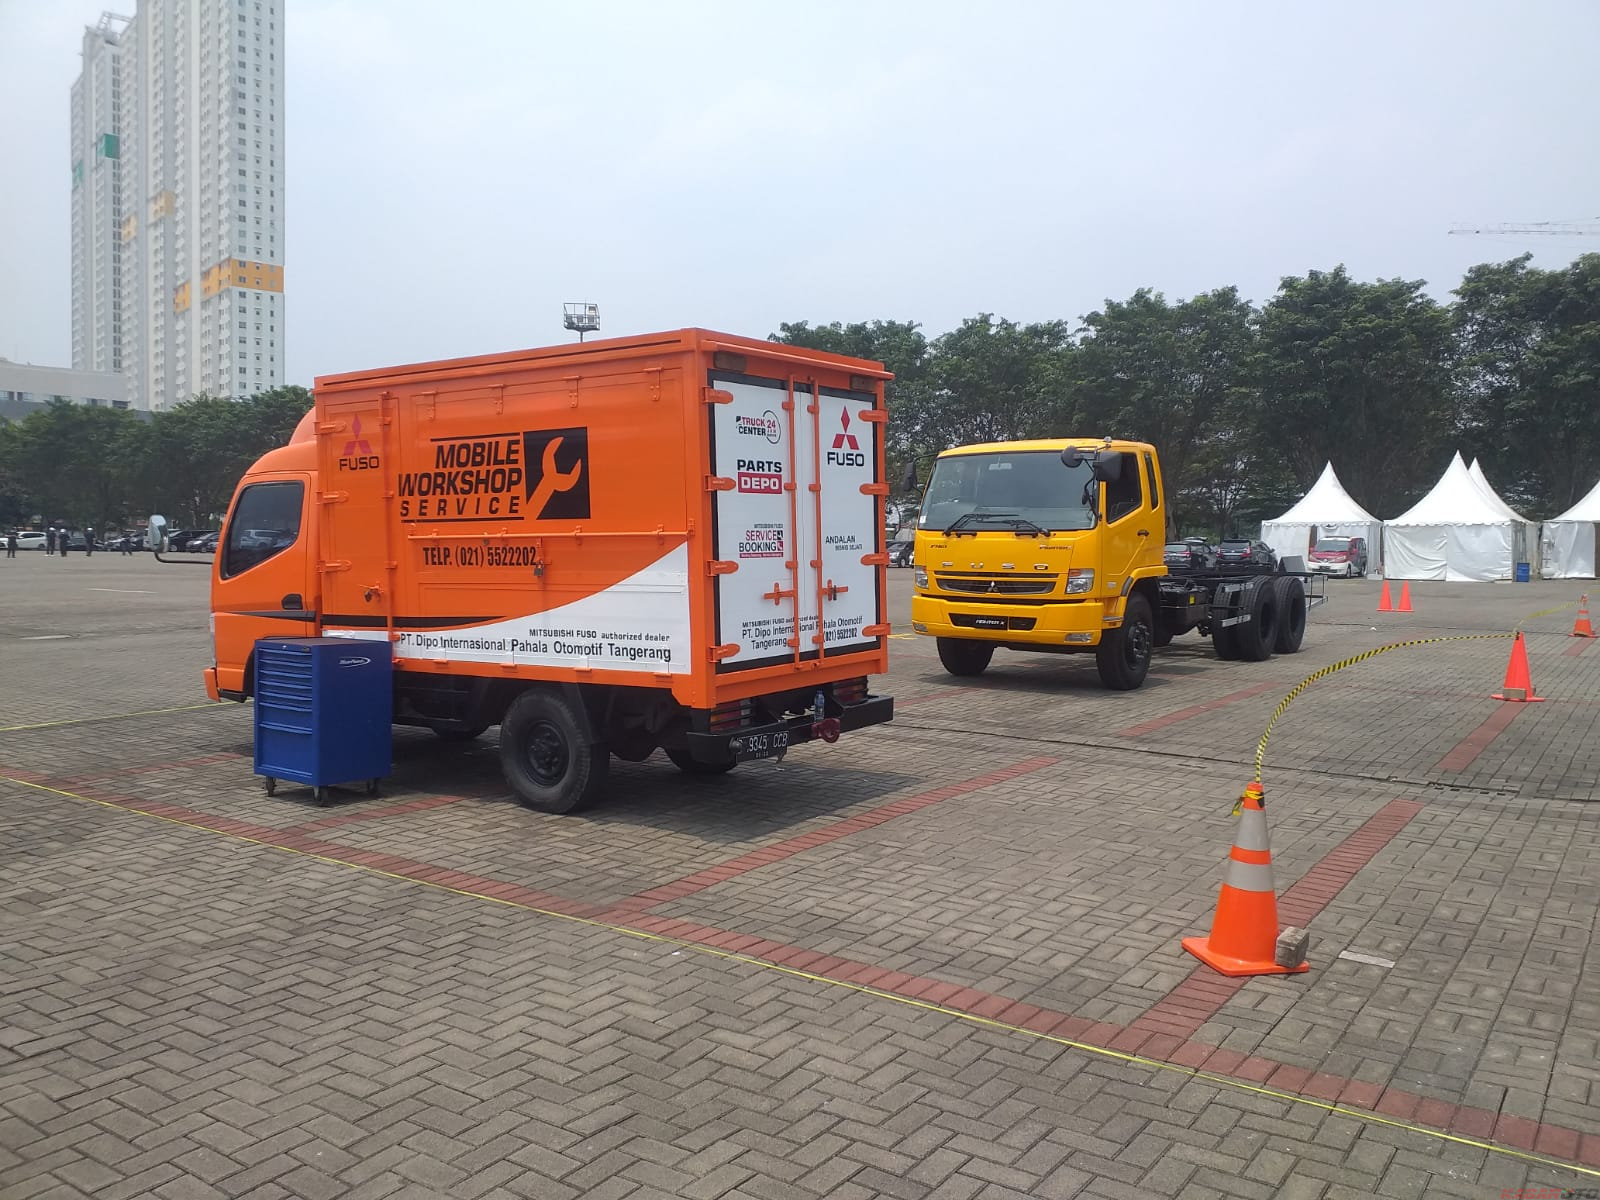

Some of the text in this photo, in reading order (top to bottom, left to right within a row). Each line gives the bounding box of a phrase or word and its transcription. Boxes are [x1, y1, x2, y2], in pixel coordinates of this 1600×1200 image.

[742, 416, 776, 429] TRUCK 24
[738, 426, 766, 436] CENTER
[435, 439, 520, 469] MOBILE
[827, 451, 864, 467] FUSO
[339, 456, 380, 471] FUSO
[737, 459, 782, 473] PARTS
[399, 468, 523, 496] WORKSHOP
[741, 476, 779, 490] DEPO
[400, 496, 520, 517] SERVICE
[745, 530, 777, 541] SERVICE
[825, 535, 856, 544] ANDALAN
[739, 541, 777, 552] BOOKING
[423, 545, 537, 568] TELP. (021) 5522202
[942, 561, 1049, 571] FUSO
[742, 629, 753, 639] PT.
[755, 628, 771, 639] Dipo
[837, 616, 864, 627] Otomotif
[529, 629, 670, 642] MITSUBISHI FUSO authorized dealer
[400, 633, 671, 662] PT. Dipo Internasional Pahala Otomotif Tangerang
[751, 638, 787, 650] Tangerang
